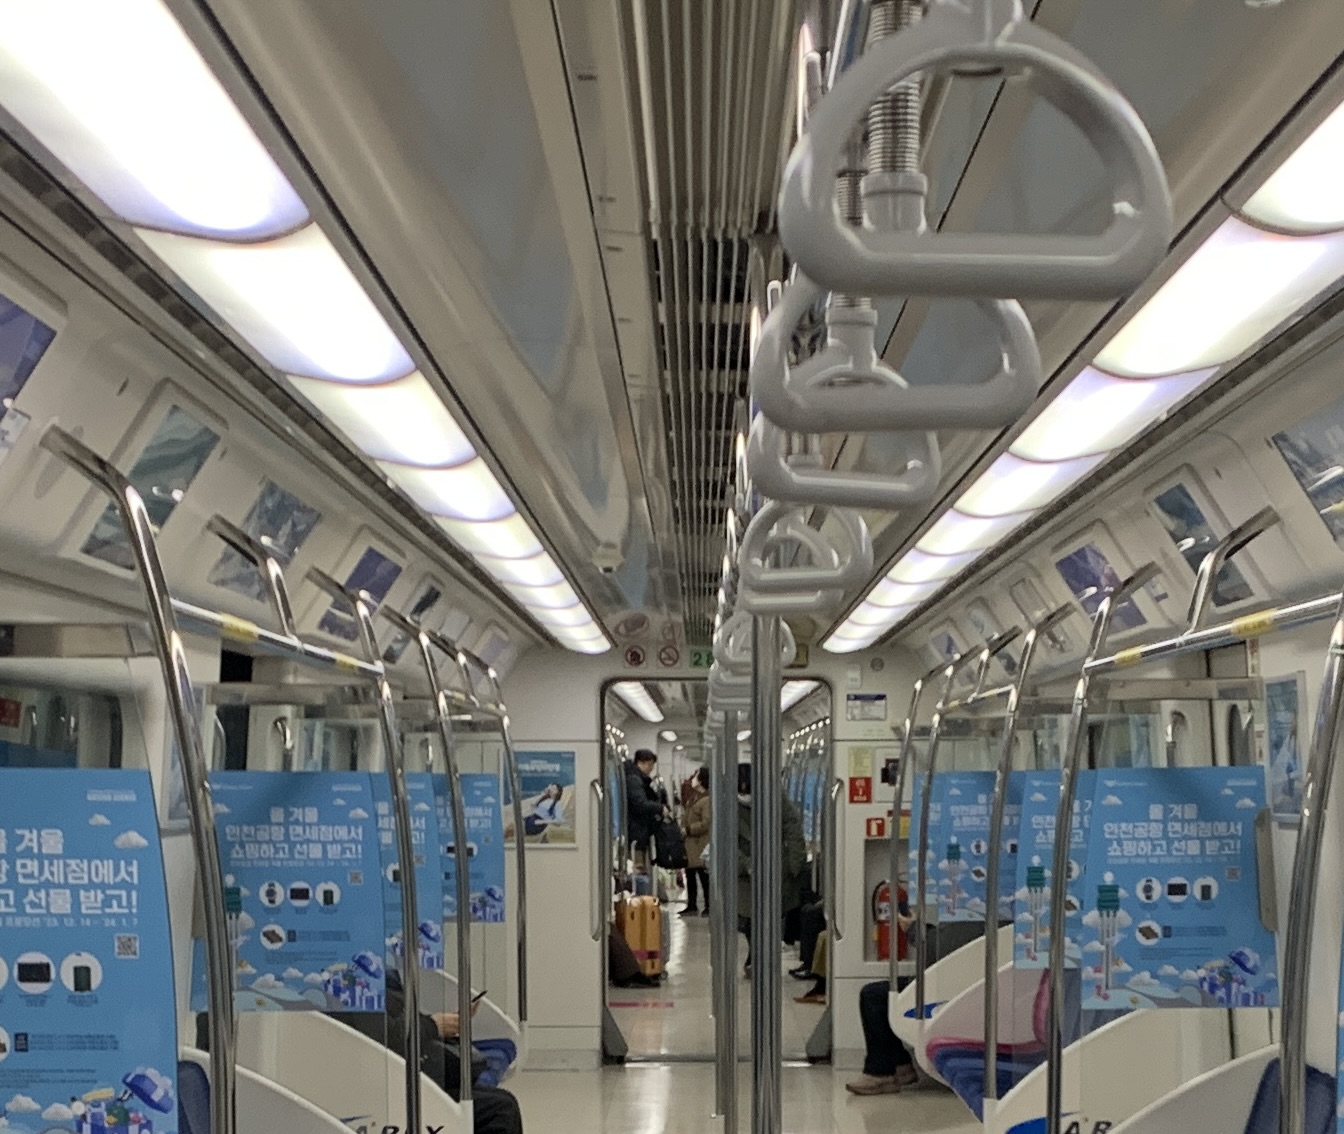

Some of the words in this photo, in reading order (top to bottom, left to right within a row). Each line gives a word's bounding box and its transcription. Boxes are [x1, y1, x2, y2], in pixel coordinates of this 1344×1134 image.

[15, 858, 139, 885] 면세점에서
[24, 889, 73, 914] 선물
[79, 889, 138, 914] 받고!
